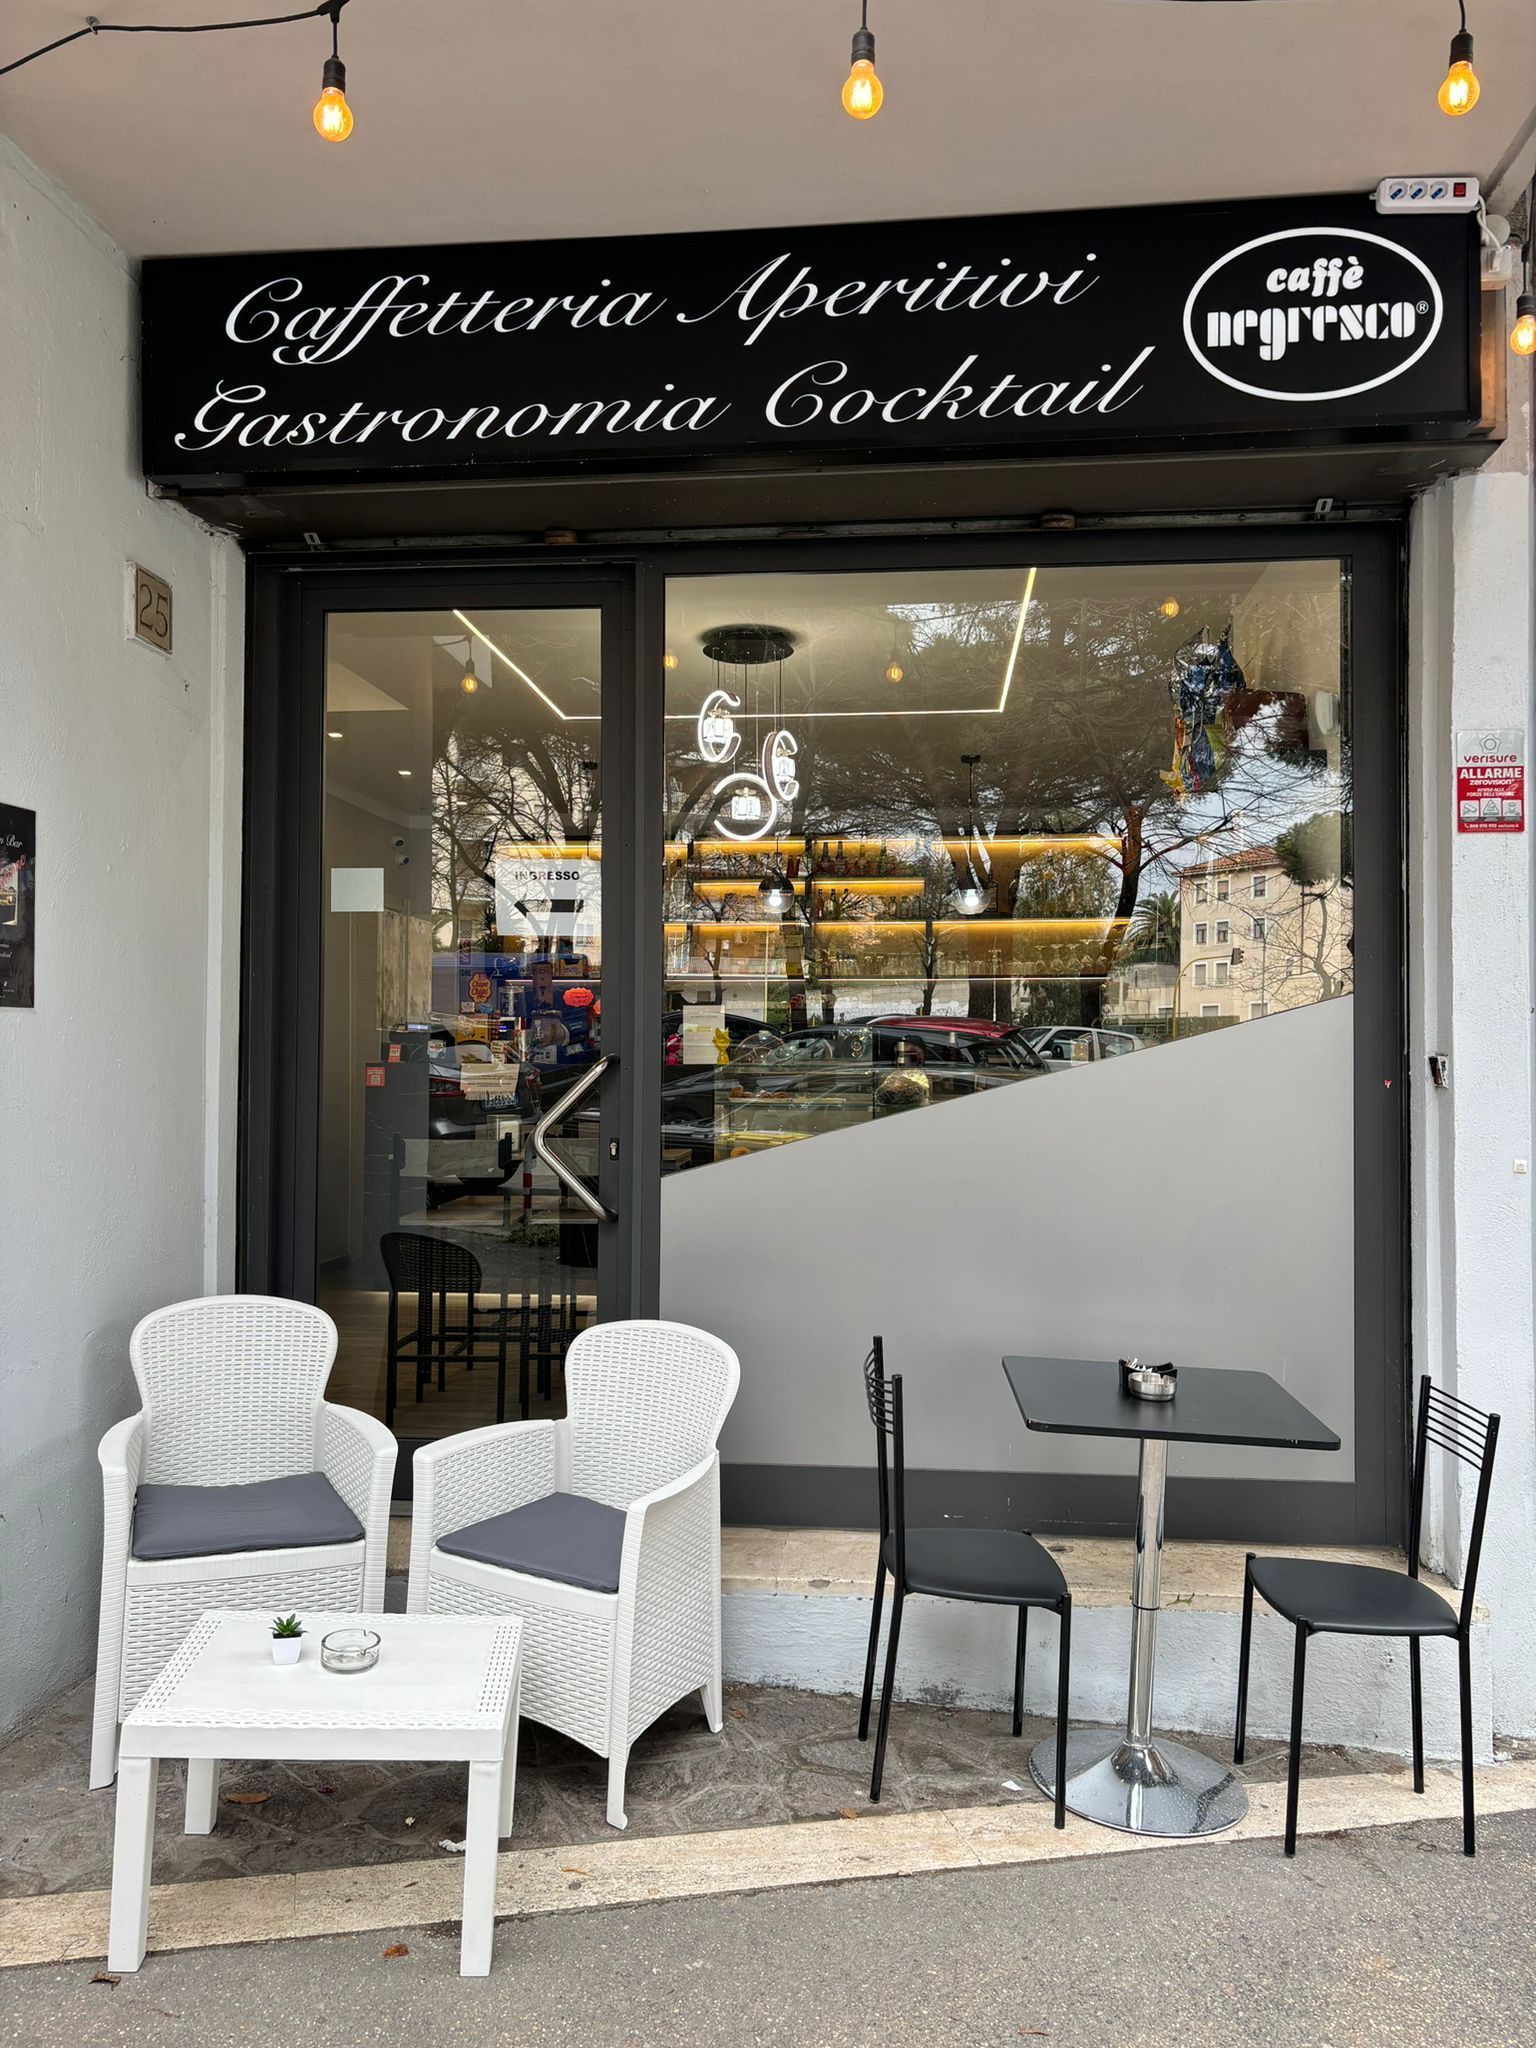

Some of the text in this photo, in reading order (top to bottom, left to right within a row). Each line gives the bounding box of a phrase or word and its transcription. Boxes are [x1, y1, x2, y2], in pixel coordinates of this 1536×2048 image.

[1266, 256, 1364, 297] caffè
[226, 253, 1099, 365] Caffetteria Aperitivi
[175, 346, 1155, 450] Gastronomia Cocktail
[140, 584, 168, 638] 25
[1460, 767, 1522, 779] ALLARME
[1464, 754, 1517, 763] verisure
[515, 871, 580, 881] INGRESSO
